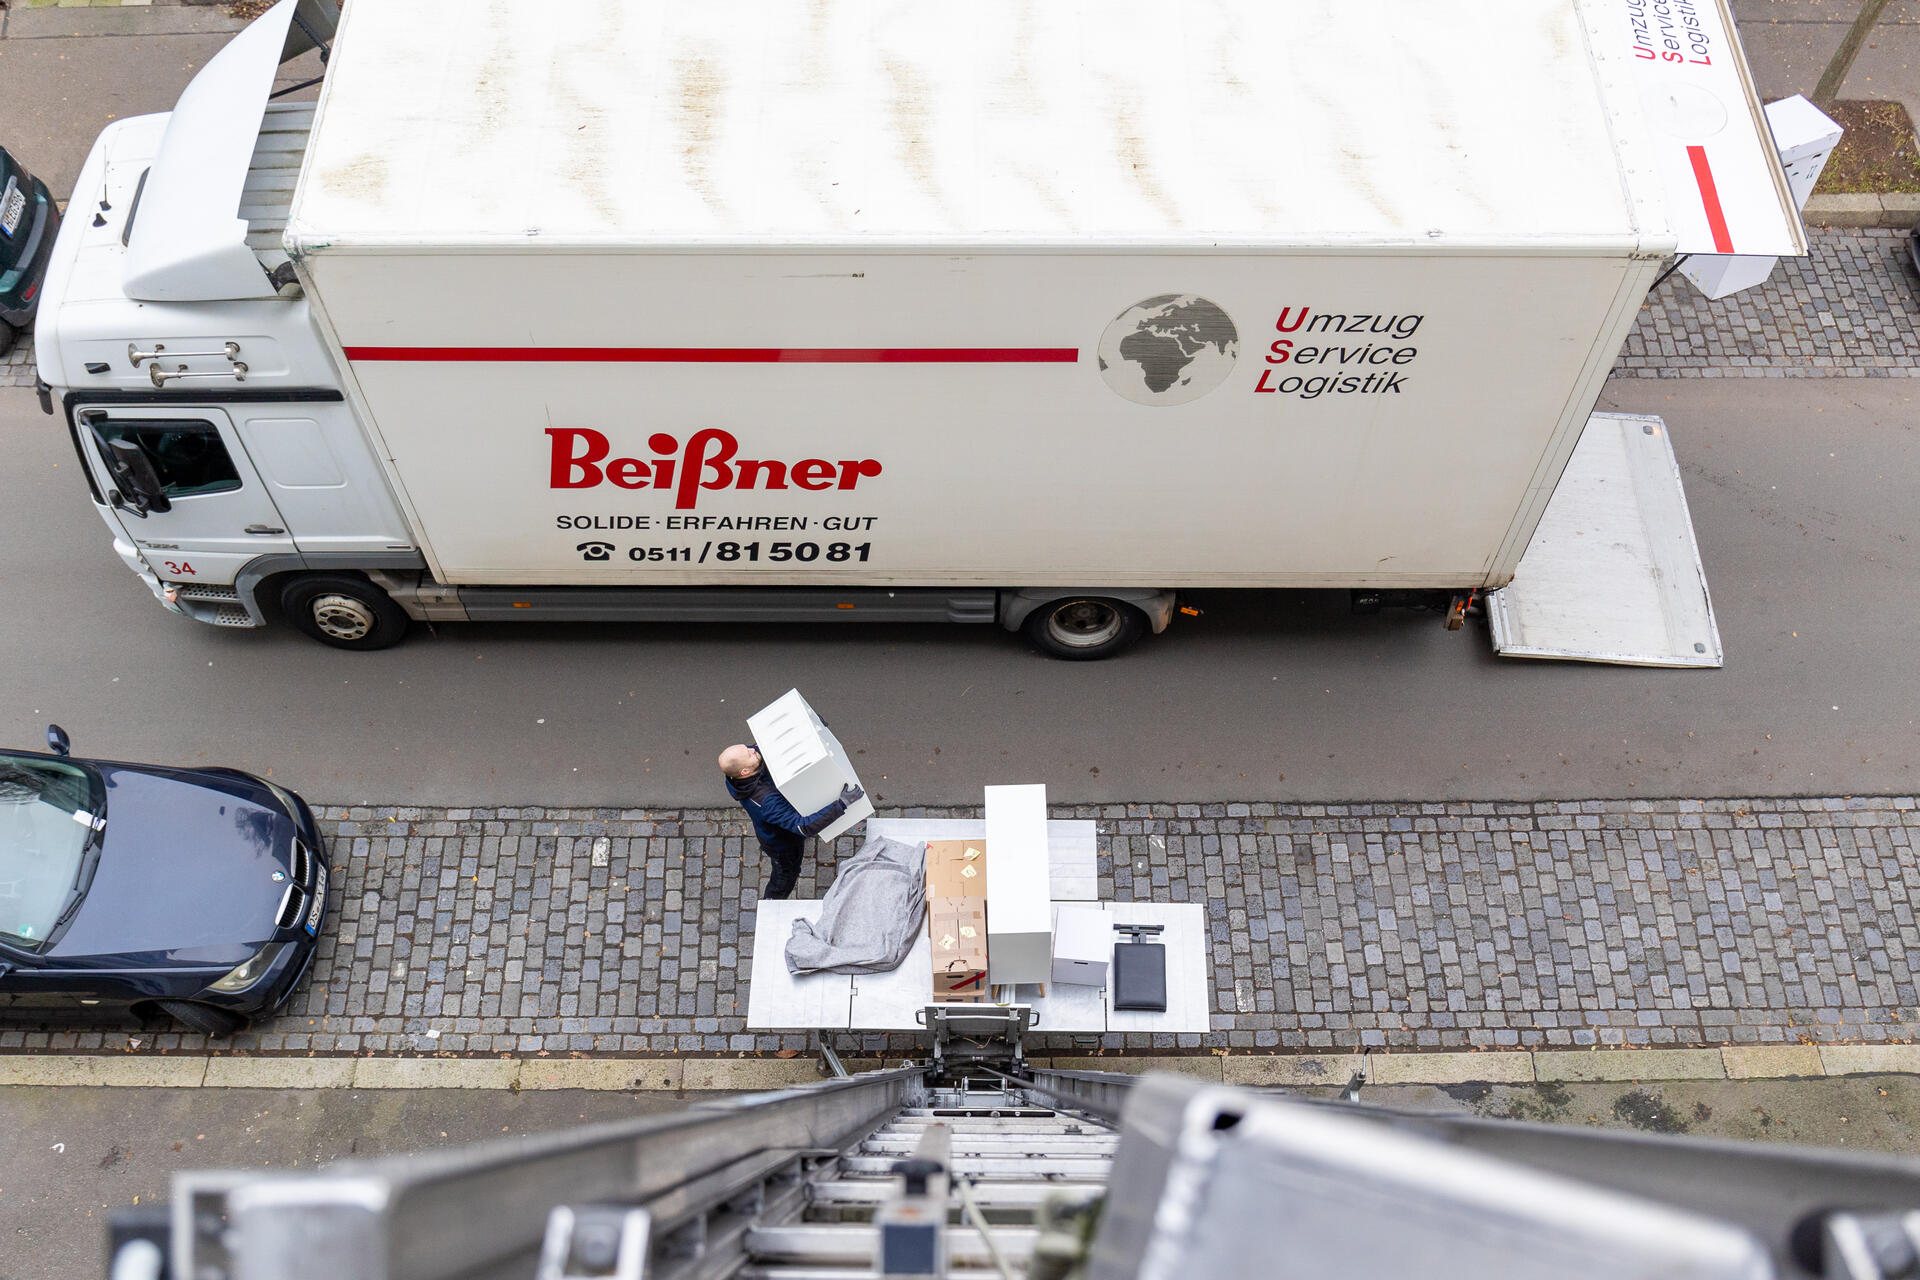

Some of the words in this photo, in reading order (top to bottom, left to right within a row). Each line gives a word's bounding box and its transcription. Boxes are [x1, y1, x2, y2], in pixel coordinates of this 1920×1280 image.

[1275, 307, 1424, 339] Umzug
[1265, 340, 1418, 364] Service
[1254, 369, 1410, 399] Logistik
[545, 428, 882, 509] Beißner
[164, 560, 197, 576] 34
